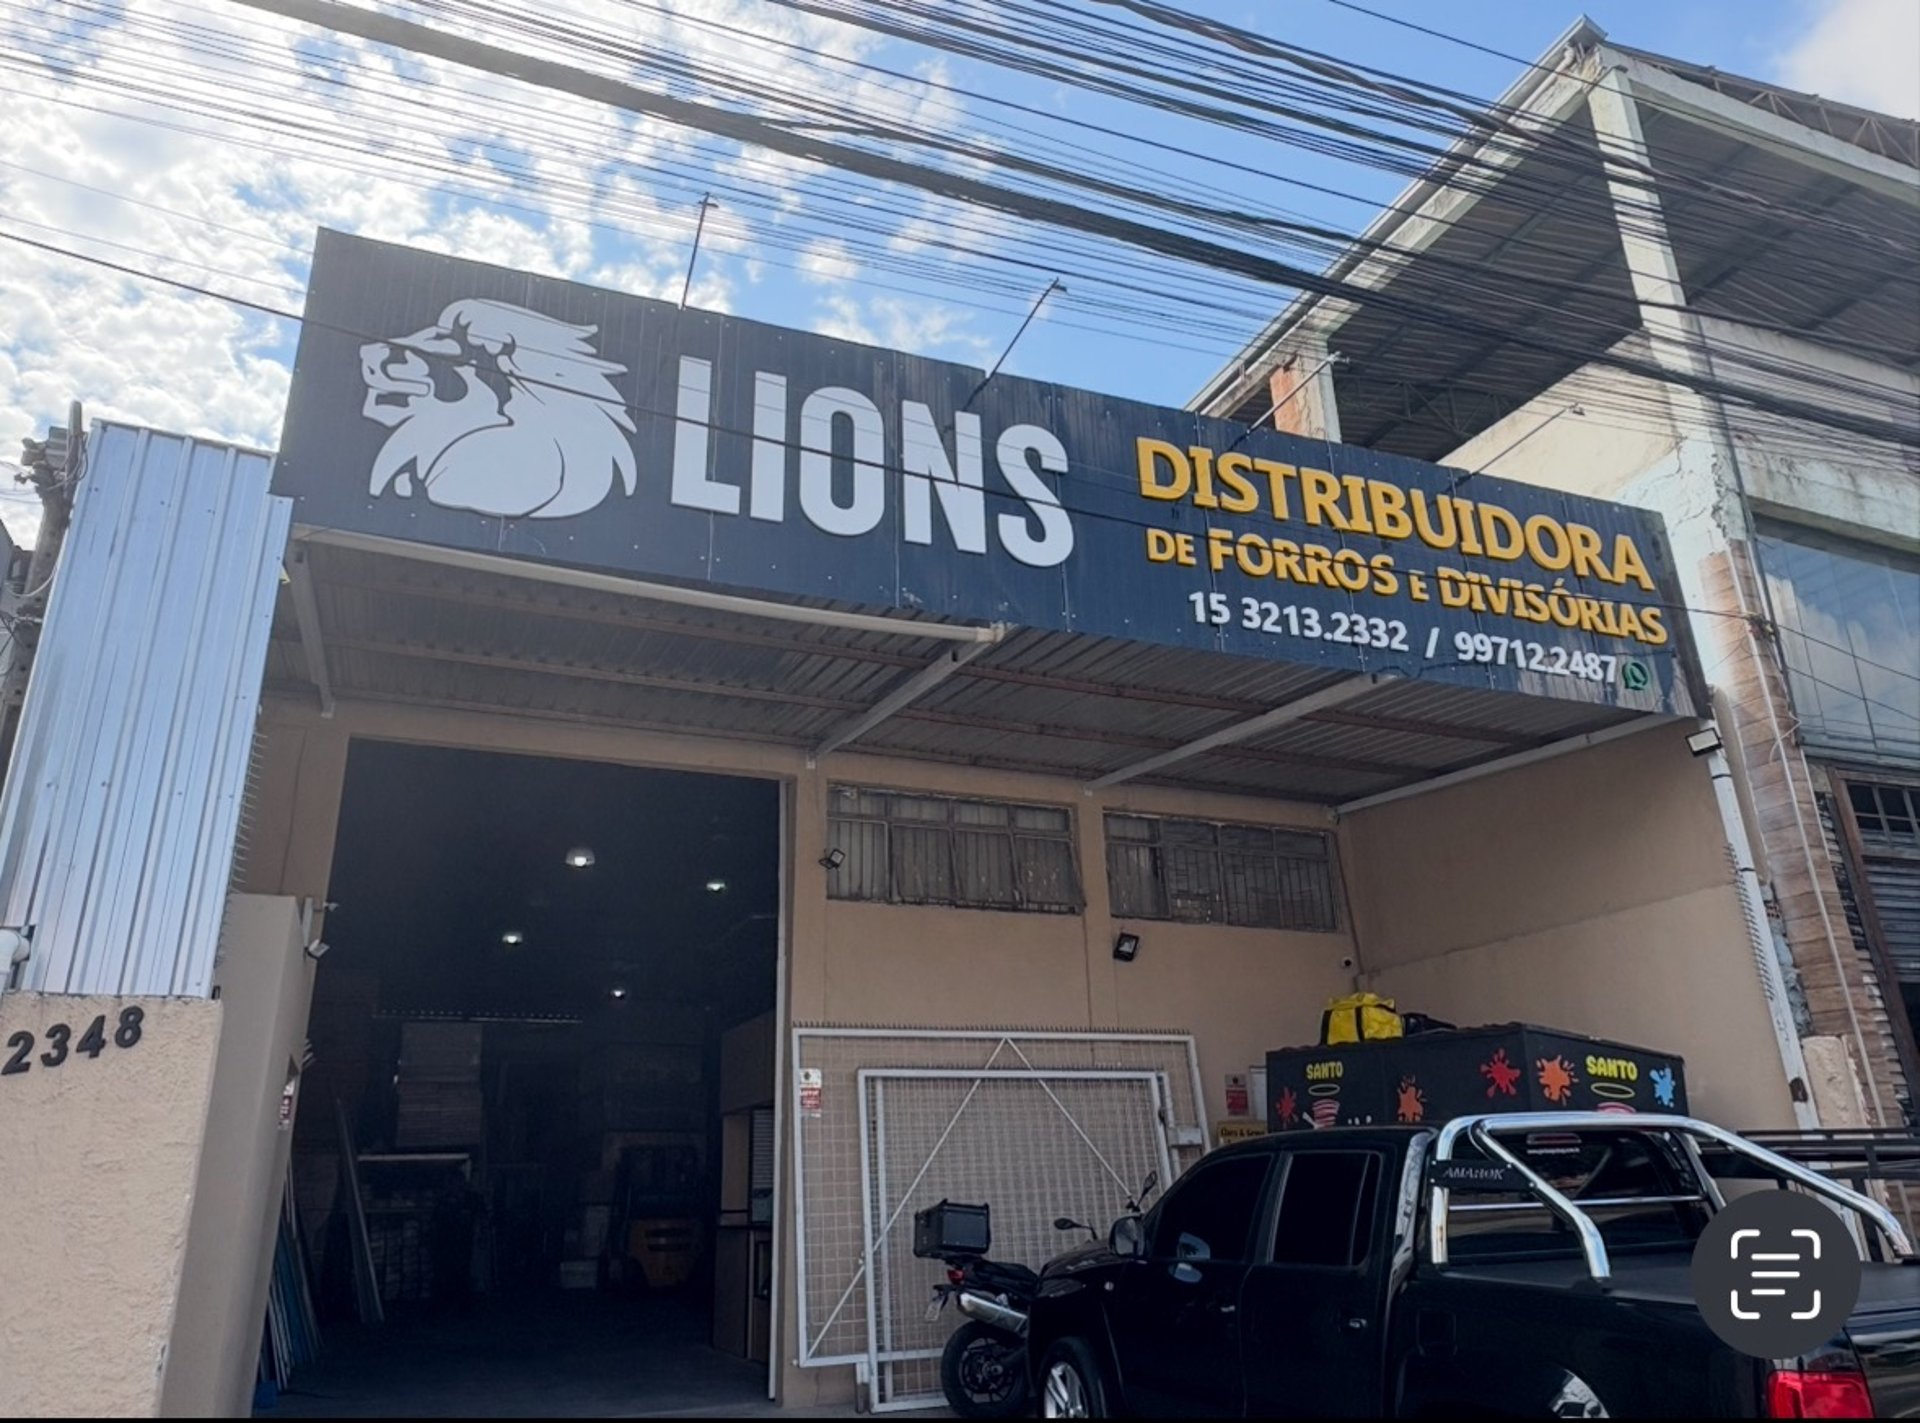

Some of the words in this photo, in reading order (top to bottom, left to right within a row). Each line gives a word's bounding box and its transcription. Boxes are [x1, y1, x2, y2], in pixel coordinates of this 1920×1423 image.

[671, 355, 1074, 567] LIONS
[1136, 437, 1655, 591] DISTRIBUIDORA
[1146, 528, 1197, 567] DE
[1208, 528, 1398, 597] FORROS
[1410, 569, 1430, 601] E
[1436, 567, 1668, 645] DIVISÓRIAS
[1189, 592, 1231, 624] 15
[1241, 597, 1409, 651] 3213.2332
[1424, 628, 1439, 659] /
[1455, 631, 1618, 684] 99712.2487
[1, 1005, 145, 1075] 2348
[1306, 1061, 1343, 1079] SANTO
[1586, 1055, 1638, 1081] SANTO
